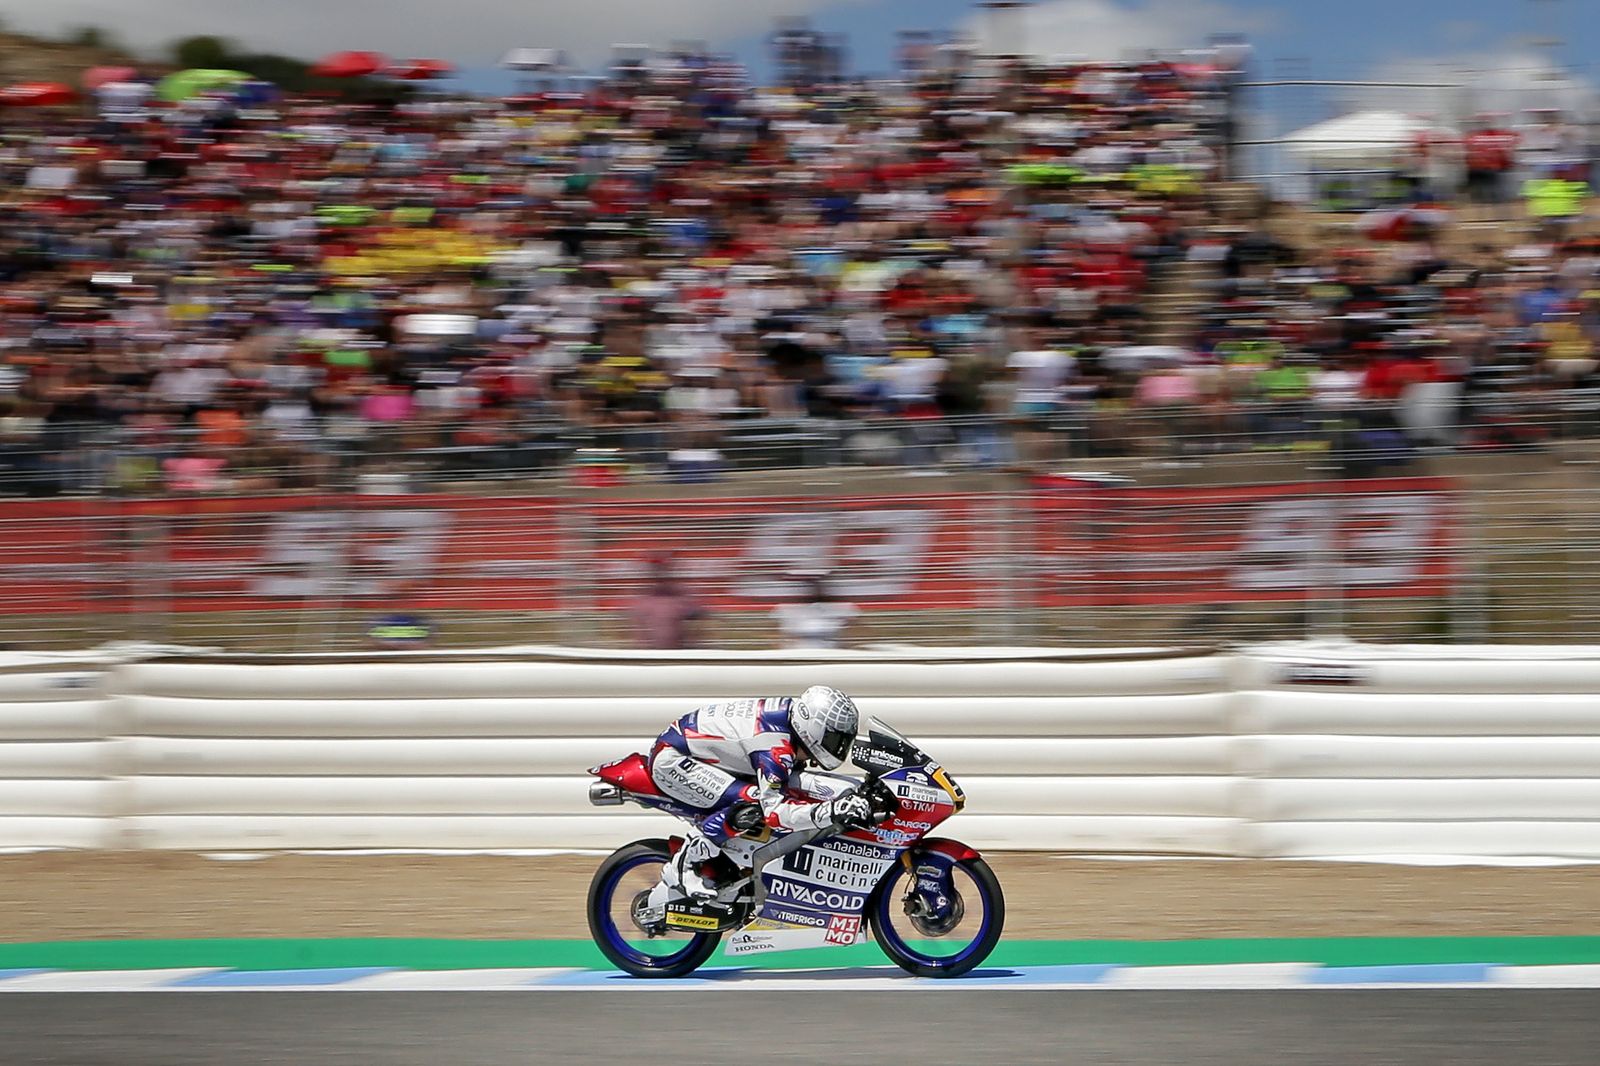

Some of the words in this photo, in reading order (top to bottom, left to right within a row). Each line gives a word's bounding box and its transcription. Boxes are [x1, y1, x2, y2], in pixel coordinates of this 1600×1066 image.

[669, 769, 715, 801] RIVACOLD
[913, 801, 936, 813] TKM
[818, 854, 883, 875] marinelli
[815, 869, 879, 887] cucine
[770, 878, 865, 911] RIVACOLD
[735, 943, 775, 952] HONDA
